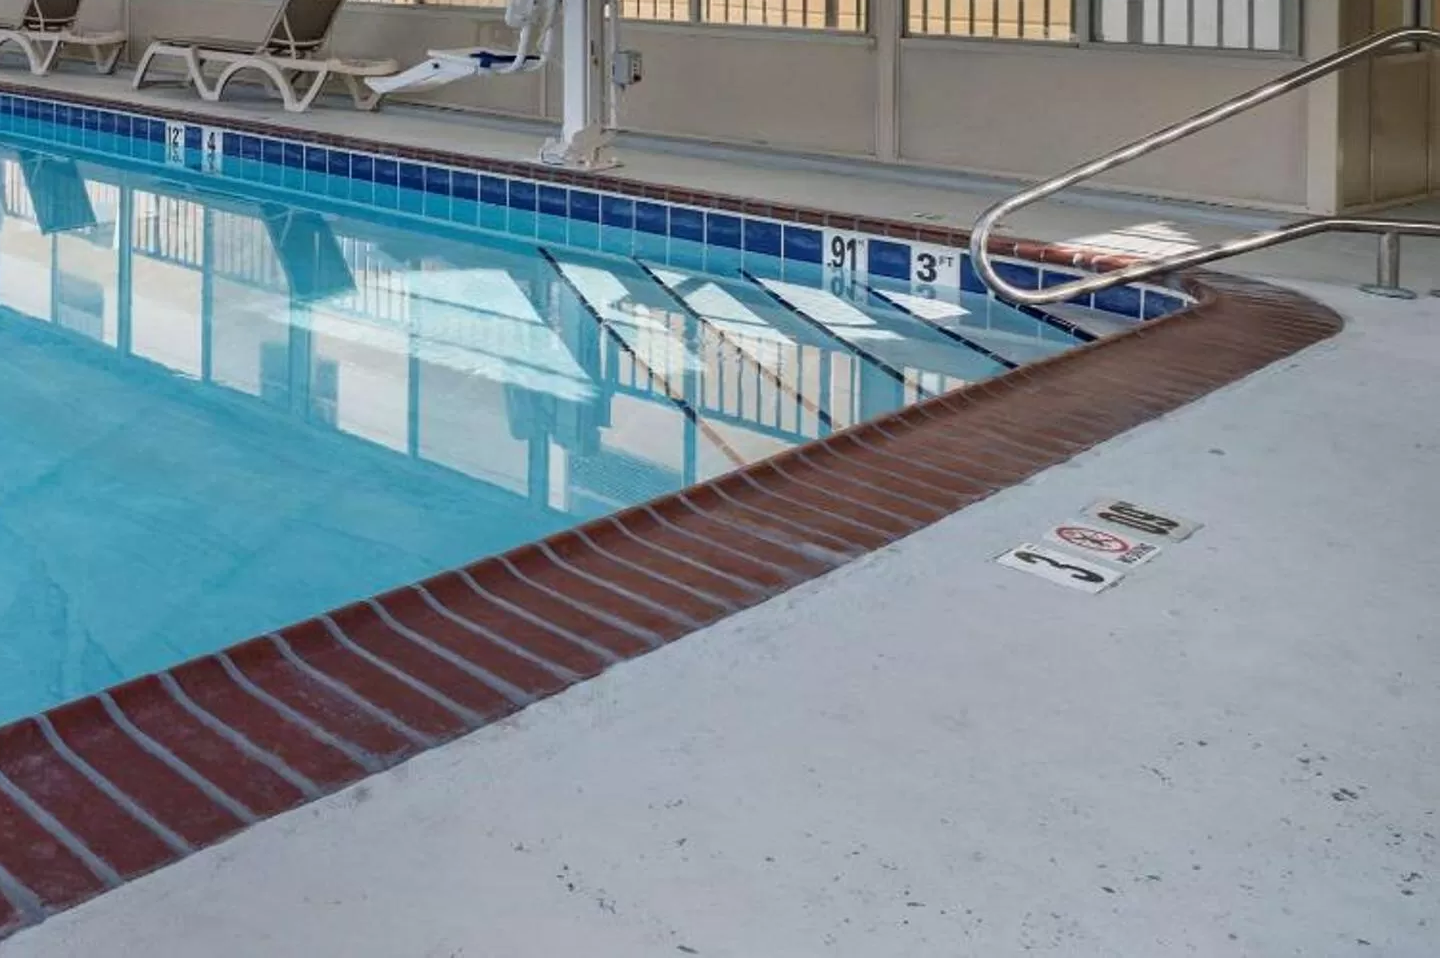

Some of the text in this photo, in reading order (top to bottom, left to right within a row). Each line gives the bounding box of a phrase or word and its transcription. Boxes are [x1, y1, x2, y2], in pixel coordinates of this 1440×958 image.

[207, 132, 216, 150] 4
[916, 252, 937, 282] 3
[1014, 550, 1105, 583] 3
